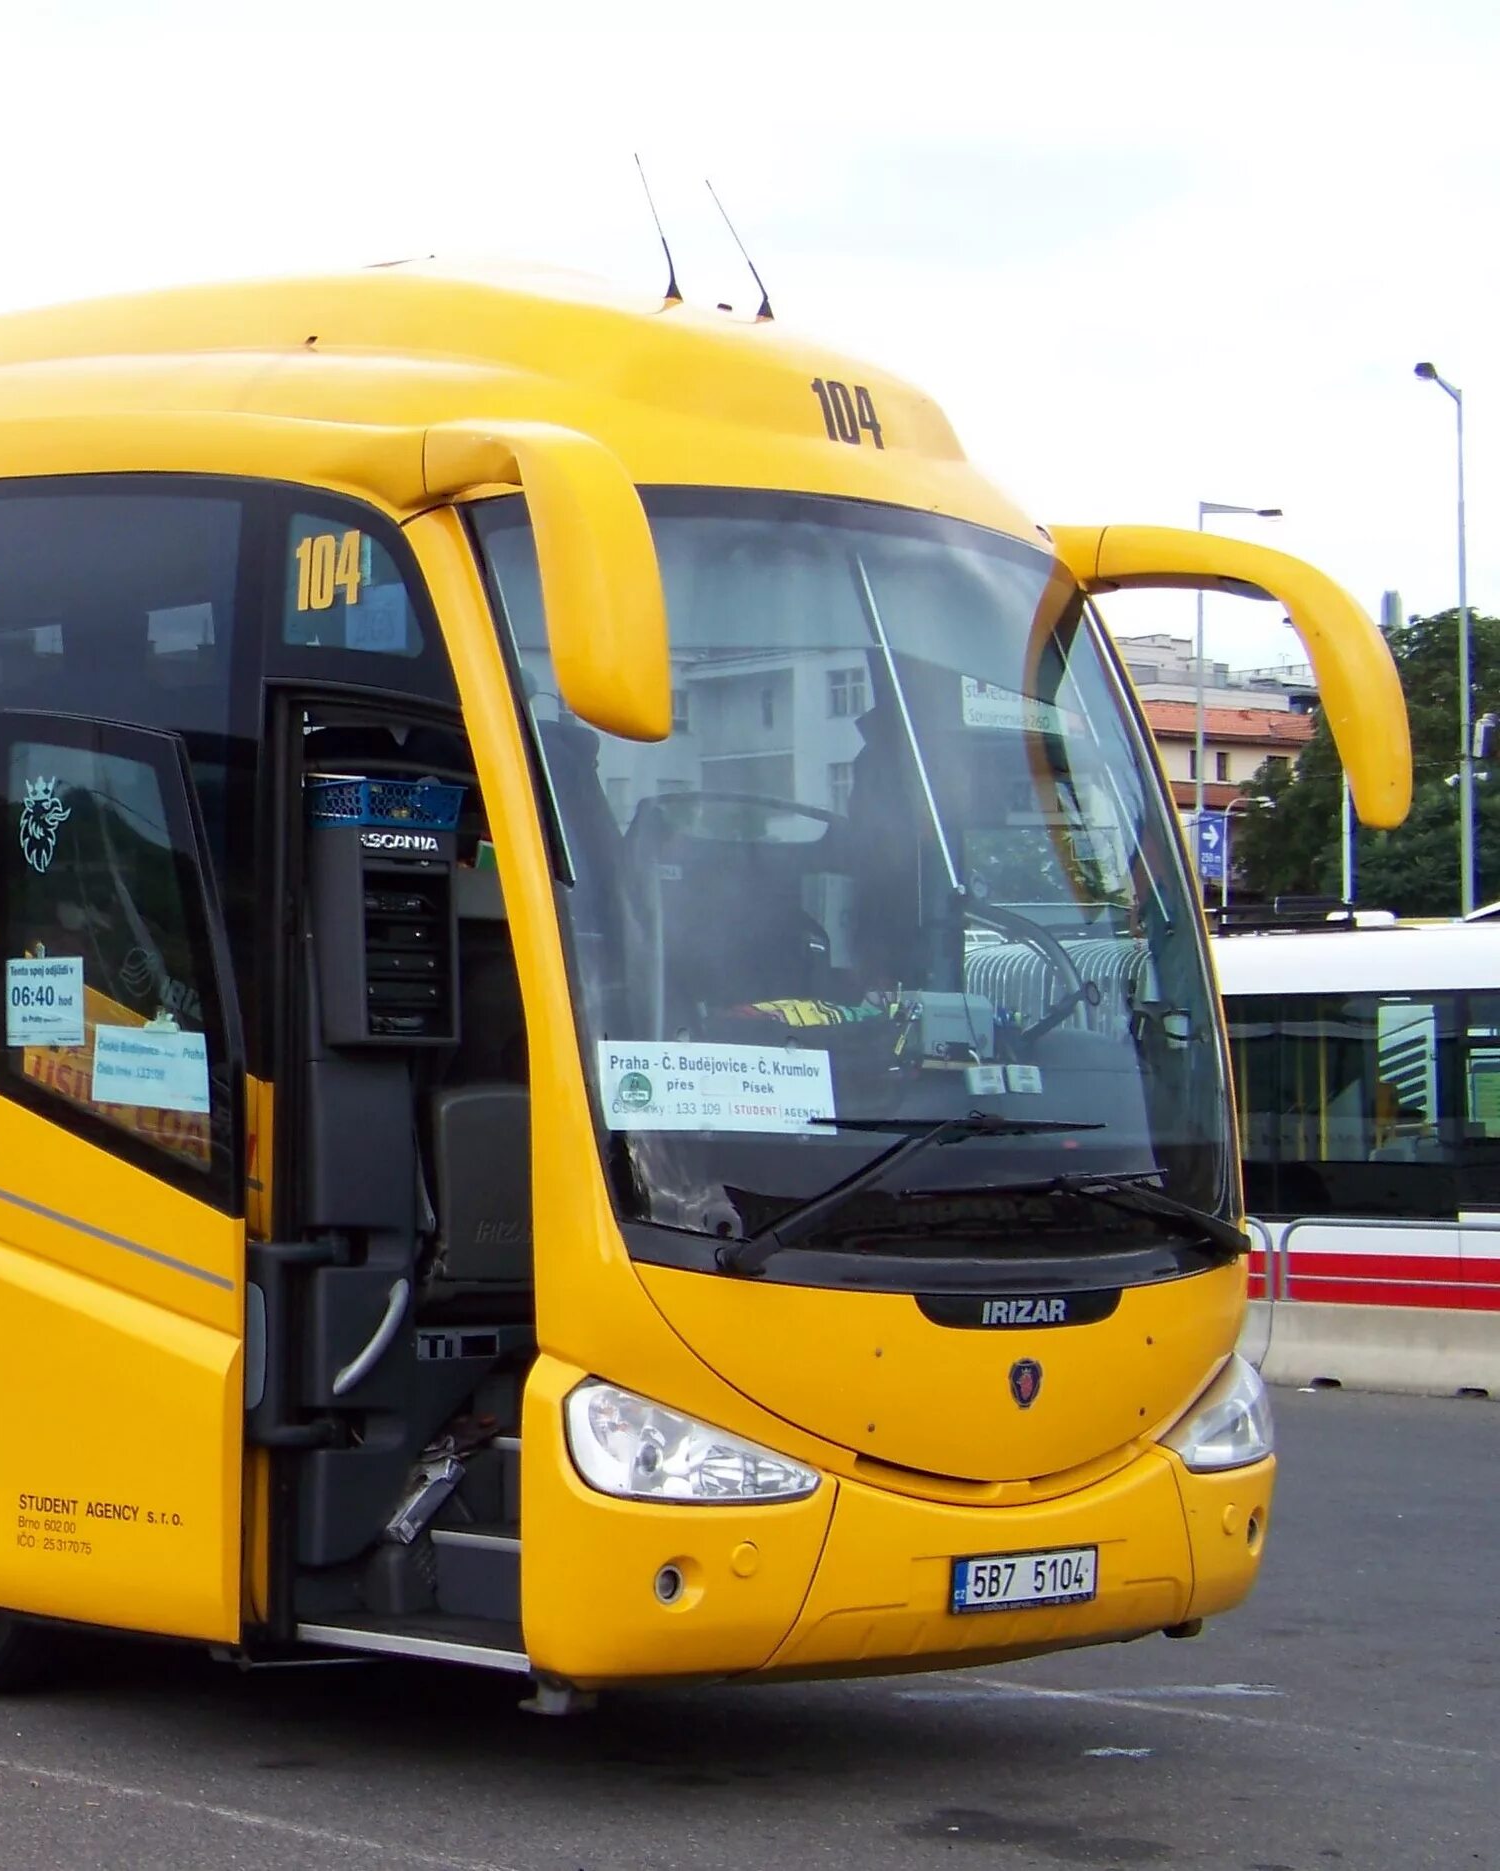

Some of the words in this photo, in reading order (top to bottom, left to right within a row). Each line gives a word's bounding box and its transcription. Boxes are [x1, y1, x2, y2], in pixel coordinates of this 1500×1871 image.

[811, 378, 886, 450] 104
[295, 529, 362, 612] 104
[363, 833, 440, 852] SCANIA
[11, 986, 55, 1007] 06:40
[610, 1055, 649, 1071] Praha
[662, 1052, 675, 1071] Č.
[678, 1055, 747, 1075] Budějovice
[758, 1057, 771, 1075] Č.
[773, 1060, 820, 1078] Krumlov
[666, 1078, 694, 1093] přes
[742, 1080, 775, 1094] Písek
[676, 1103, 697, 1115] 133
[702, 1103, 721, 1115] 109
[733, 1105, 778, 1116] STUDENT
[784, 1107, 821, 1118] AGENCY
[982, 1299, 1067, 1325] IRIZAR
[18, 1493, 79, 1516] STUDENT
[85, 1501, 140, 1522] AGENCY
[147, 1510, 158, 1524] s.
[160, 1512, 169, 1525] r.
[172, 1513, 184, 1527] o.
[18, 1515, 40, 1531] Brno
[973, 1562, 1017, 1598] 5B7
[1033, 1557, 1086, 1593] 5104
[954, 1589, 966, 1601] CZ
